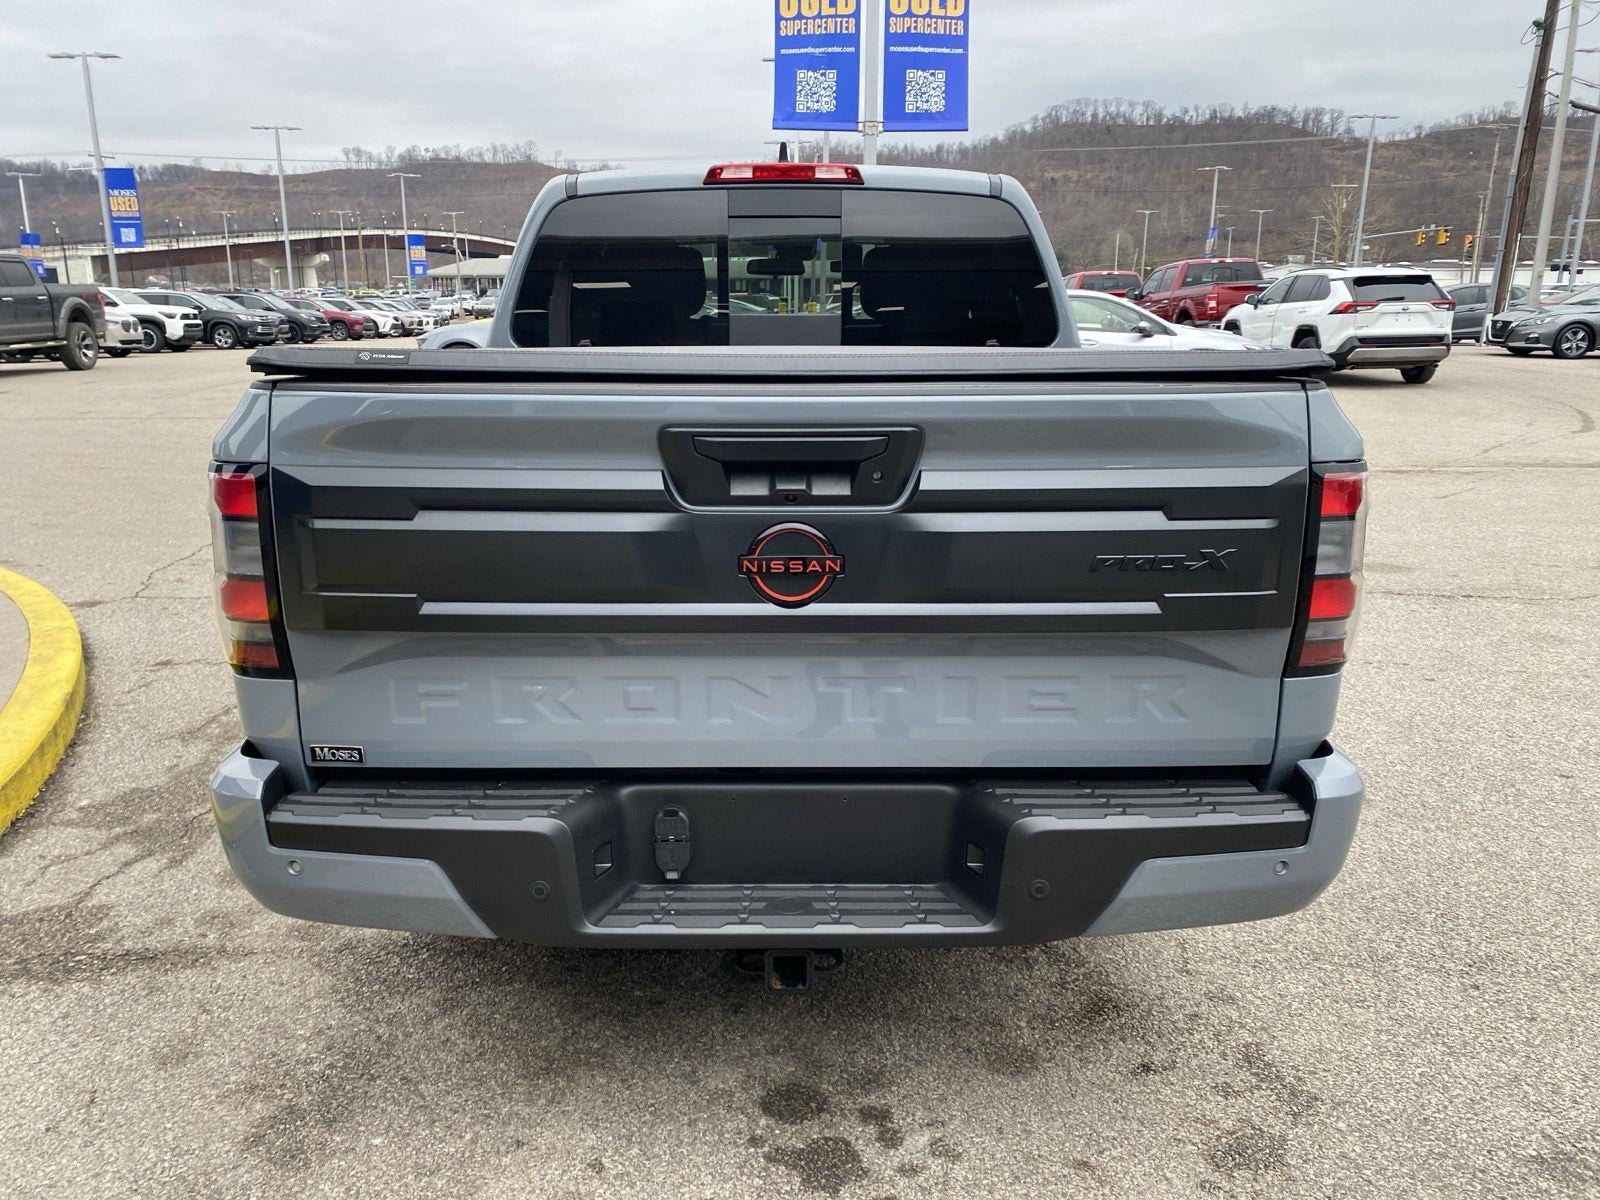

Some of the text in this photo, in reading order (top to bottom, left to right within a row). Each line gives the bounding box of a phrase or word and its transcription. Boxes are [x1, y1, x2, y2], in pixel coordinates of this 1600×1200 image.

[780, 17, 856, 37] SUPERCENTER
[889, 16, 965, 36] SUPERCENTER
[780, 46, 856, 55] mosesusedsupercenter.com
[889, 45, 964, 54] mosesusedsupercenter.com
[110, 196, 139, 211] USED
[742, 559, 841, 573] NISSAN
[1089, 548, 1238, 572] PRO-X
[390, 675, 1190, 726] FRONTIER
